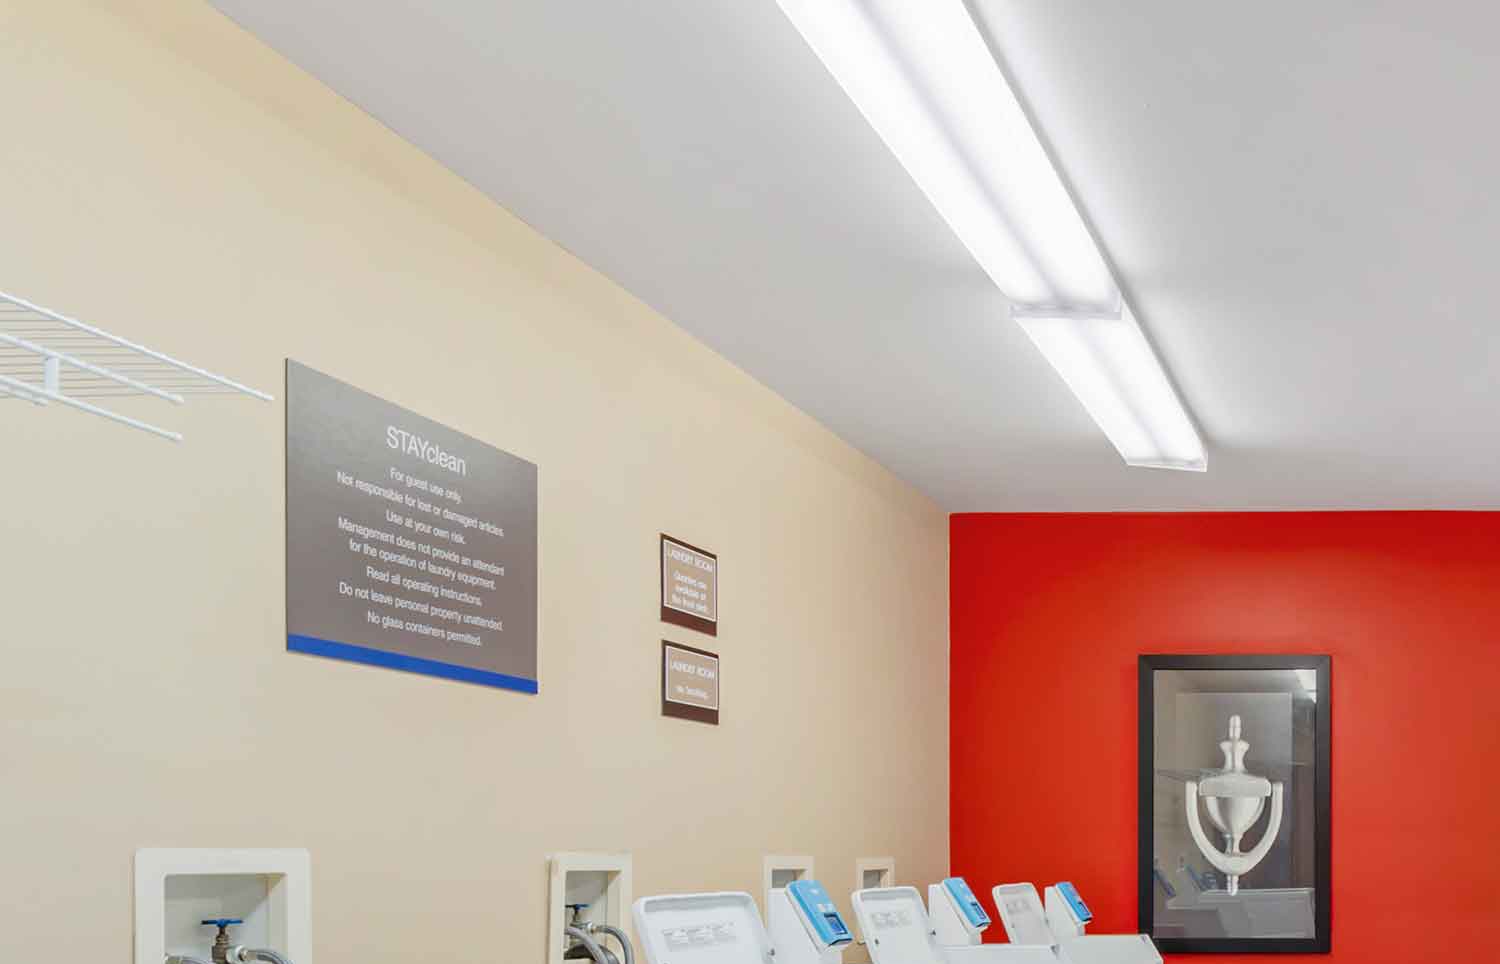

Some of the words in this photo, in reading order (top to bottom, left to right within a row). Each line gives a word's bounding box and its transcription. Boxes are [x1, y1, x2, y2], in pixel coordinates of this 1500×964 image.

[386, 425, 466, 476] STAYclean
[336, 471, 353, 486] Not
[354, 479, 403, 504] responsible
[404, 494, 416, 507] for
[432, 505, 441, 516] or
[442, 508, 478, 529] damaged
[389, 467, 404, 482] For
[405, 474, 428, 491] guest
[429, 483, 444, 497] use
[338, 516, 395, 545] Management
[396, 535, 417, 551] does
[417, 543, 431, 556] not
[431, 546, 460, 564] provide
[385, 509, 403, 526] Use
[404, 517, 414, 529] at
[414, 521, 432, 537] your
[432, 527, 449, 541] own
[349, 538, 361, 553] for
[362, 543, 377, 557] the
[379, 549, 417, 568] operation
[418, 559, 427, 572] of
[427, 560, 456, 582] laundry
[366, 565, 390, 583] Read
[390, 573, 401, 585] all
[402, 577, 440, 599] operating
[339, 581, 353, 597] Do
[354, 587, 369, 601] not
[370, 588, 393, 605] leave
[395, 598, 429, 615] personal
[430, 606, 462, 625] property
[367, 609, 381, 625] No
[381, 615, 404, 630] glass
[405, 622, 446, 640] containers
